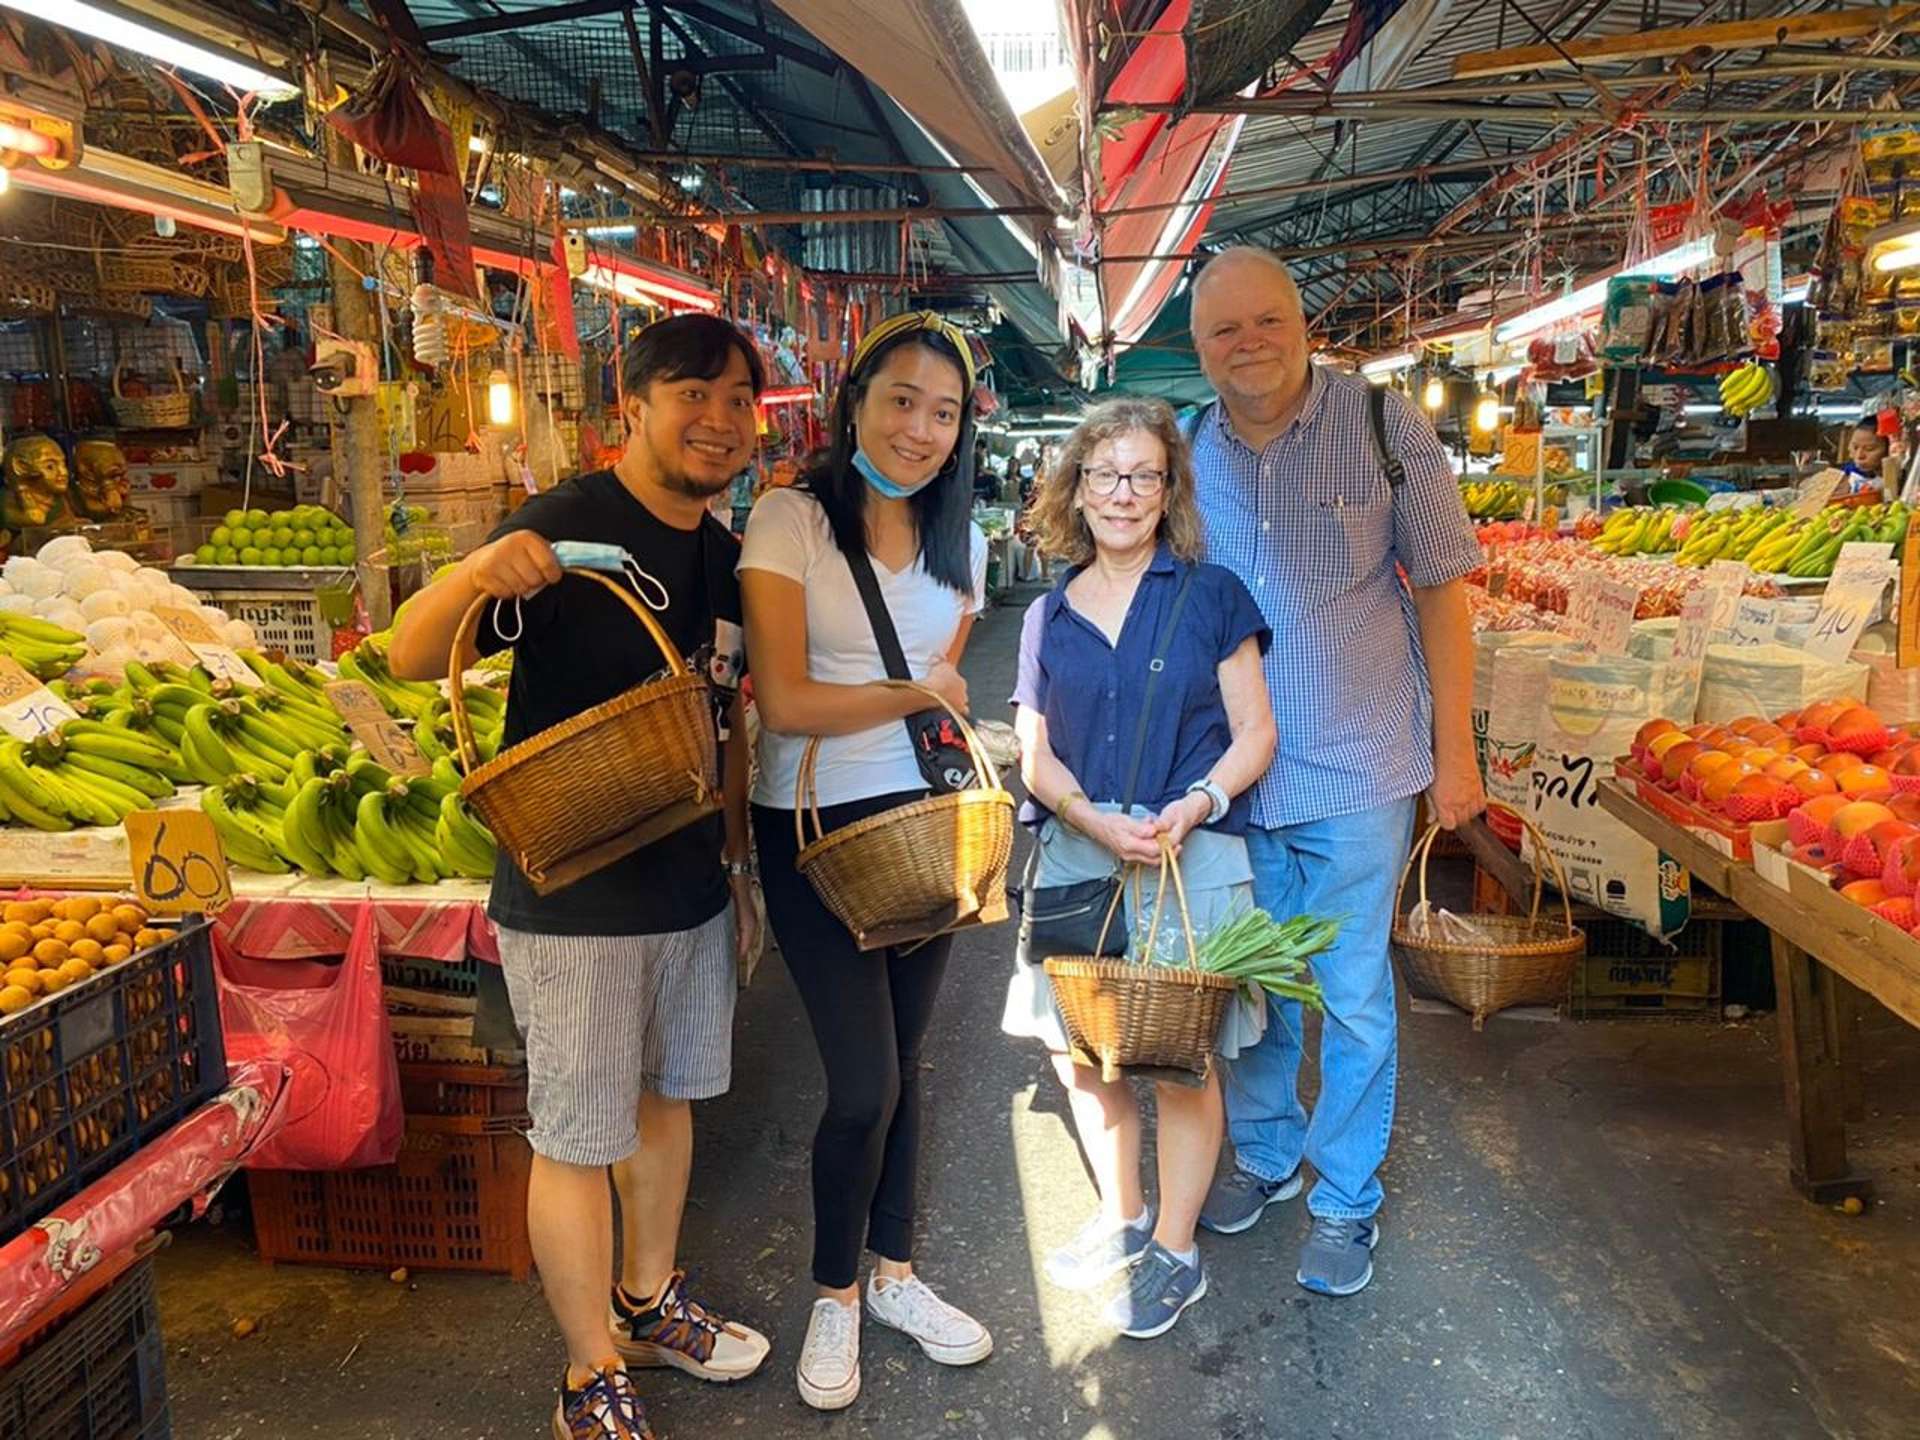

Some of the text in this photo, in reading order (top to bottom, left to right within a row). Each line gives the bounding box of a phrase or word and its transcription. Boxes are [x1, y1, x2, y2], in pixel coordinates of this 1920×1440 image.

[1507, 442, 1538, 470] 20
[1816, 608, 1856, 643] 40
[143, 820, 222, 901] 60
